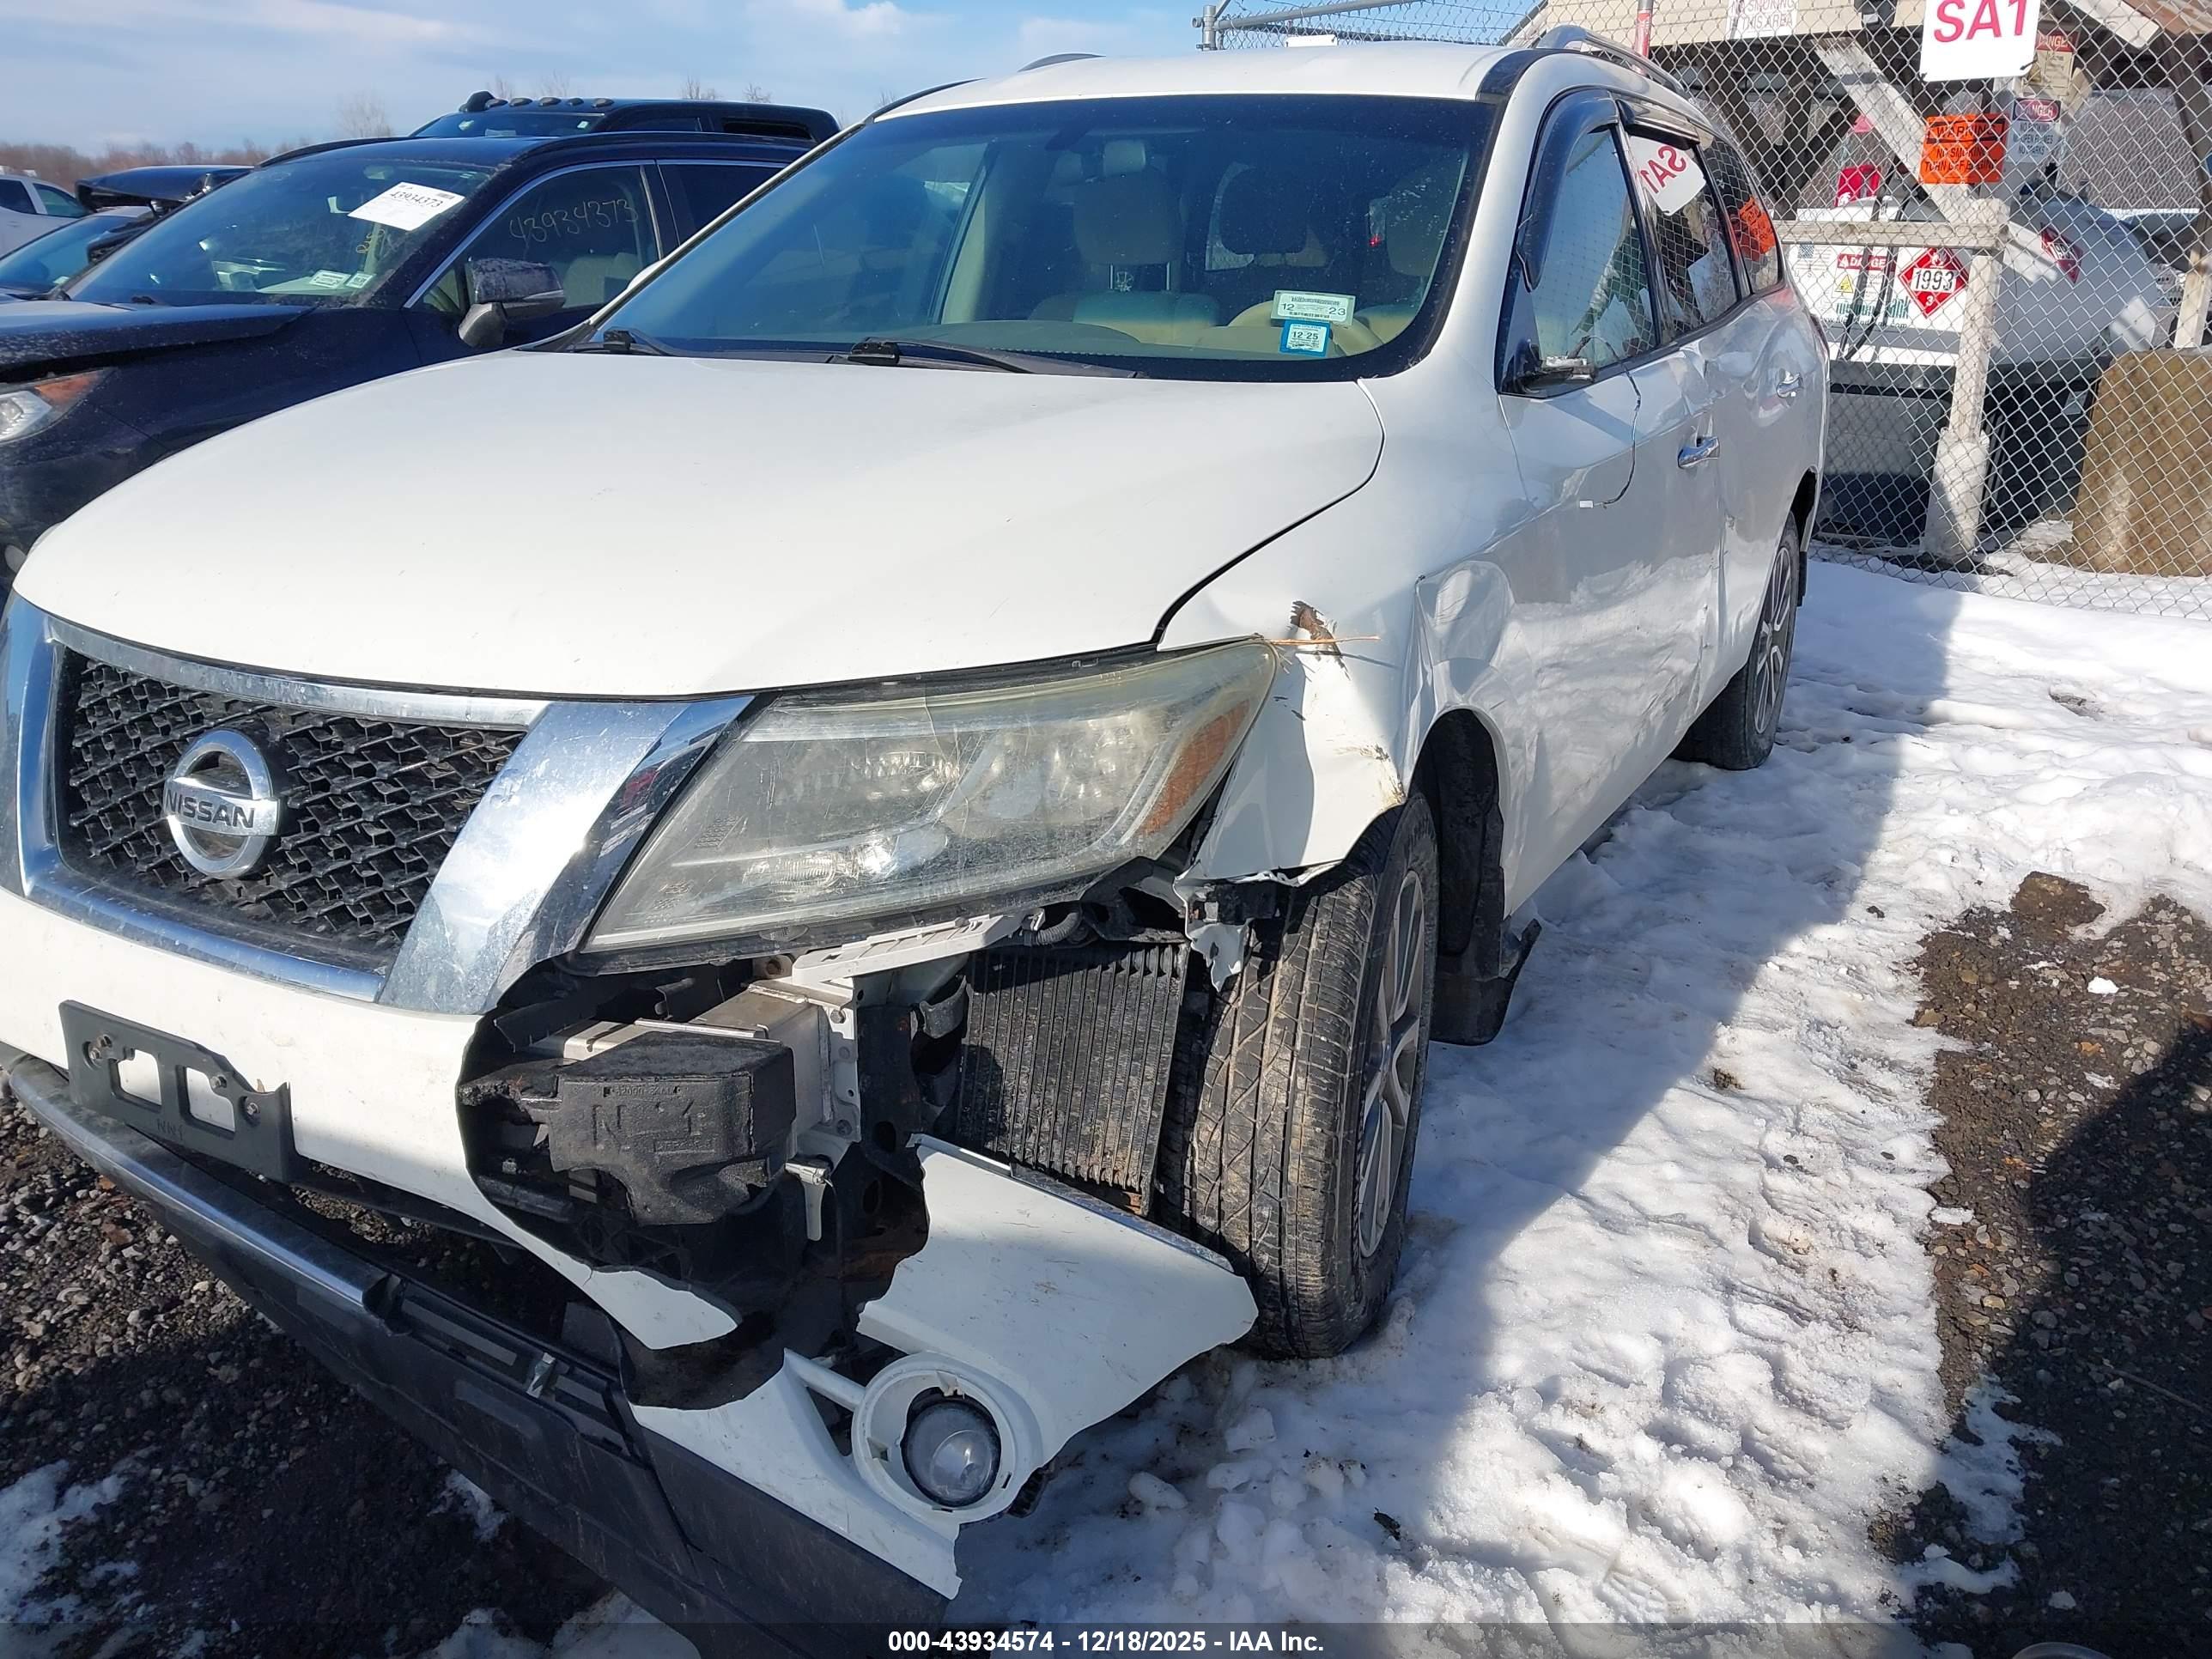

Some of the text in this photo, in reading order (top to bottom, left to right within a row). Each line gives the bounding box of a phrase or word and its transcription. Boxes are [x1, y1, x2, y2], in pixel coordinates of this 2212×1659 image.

[1934, 0, 2028, 43] SA1
[509, 198, 639, 248] 43934373
[1916, 270, 1954, 290] 1993
[1328, 307, 1346, 316] 23
[1926, 295, 1935, 307] 3
[165, 788, 255, 829] NISSAN
